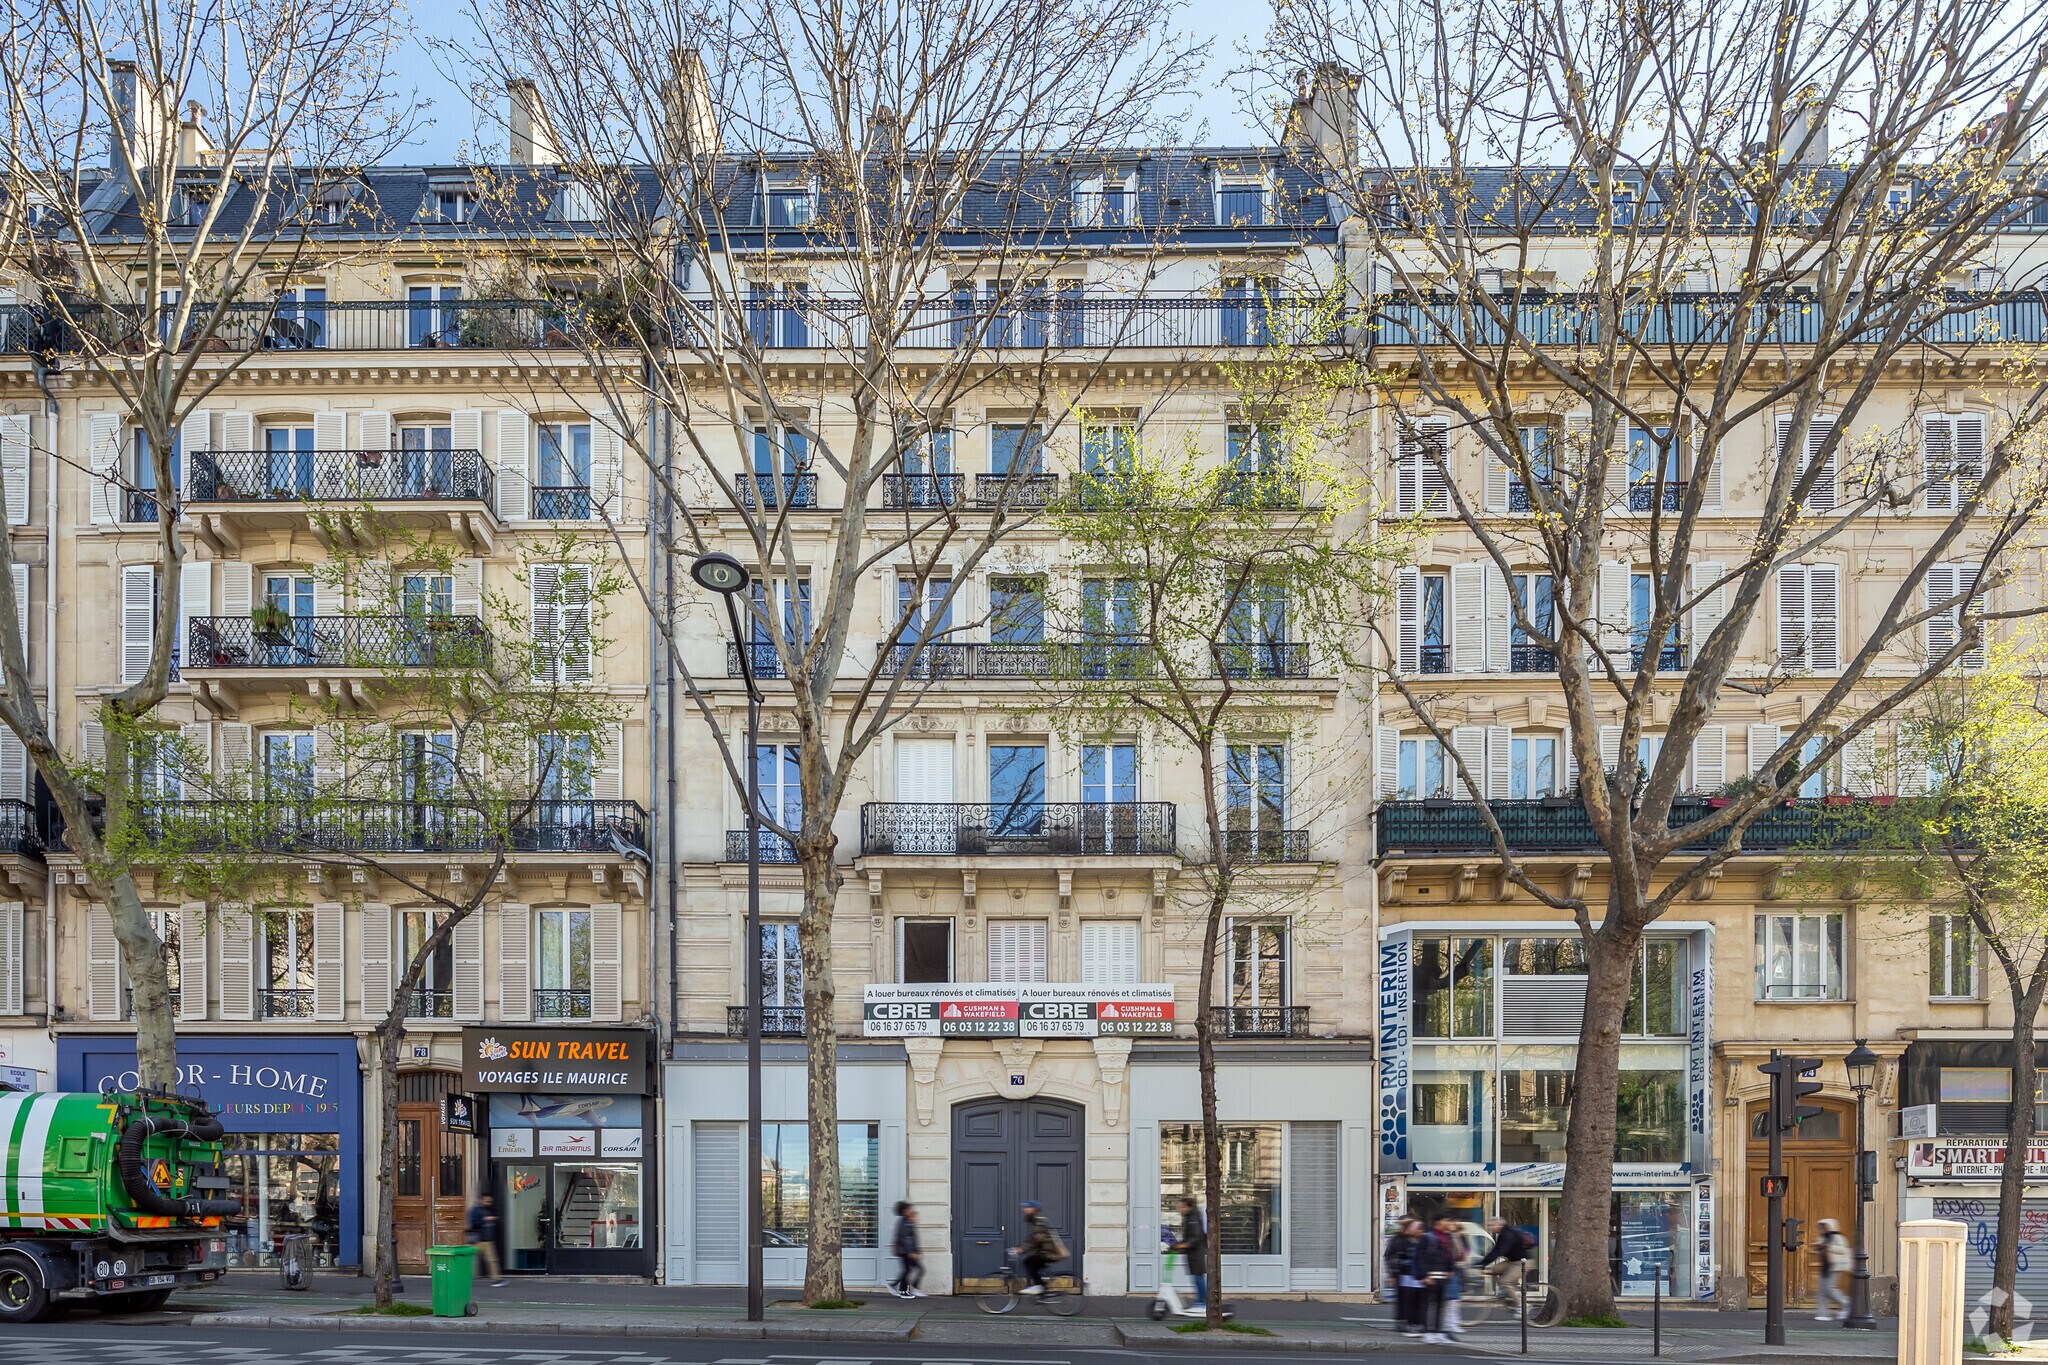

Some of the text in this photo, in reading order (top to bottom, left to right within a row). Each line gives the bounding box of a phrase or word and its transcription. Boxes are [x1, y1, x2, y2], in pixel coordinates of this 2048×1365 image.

[1398, 942, 1408, 1012] INSERTION
[873, 1004, 931, 1018] CBRE
[1029, 1004, 1088, 1018] CBRE
[1380, 944, 1398, 1089] RM INTERIM
[871, 1021, 927, 1031] 06 16 37 65 79
[943, 1022, 1015, 1032] 06 03 12 22 38
[1027, 1021, 1084, 1031] 06 16 37 65 79
[1101, 1022, 1172, 1032] 06 03 12 22 38
[1692, 970, 1700, 1082] RM INTERIM
[1398, 1025, 1407, 1046] CDI
[415, 1048, 426, 1056] 78
[510, 1041, 629, 1060] SUN TRAVEL
[478, 1071, 628, 1084] VOYAGES ILE MAURICE
[1398, 1060, 1407, 1086] CDD
[230, 1064, 328, 1098] HOME
[1012, 1076, 1023, 1084] 76
[264, 1103, 312, 1114] DEPUIS
[316, 1102, 338, 1113] 1975
[1947, 1138, 1999, 1146] RÉPARATION
[1936, 1148, 1999, 1163] SMART
[1956, 1166, 1987, 1174] INTERNET
[100, 1262, 108, 1275] 80
[116, 1262, 124, 1274] 90
